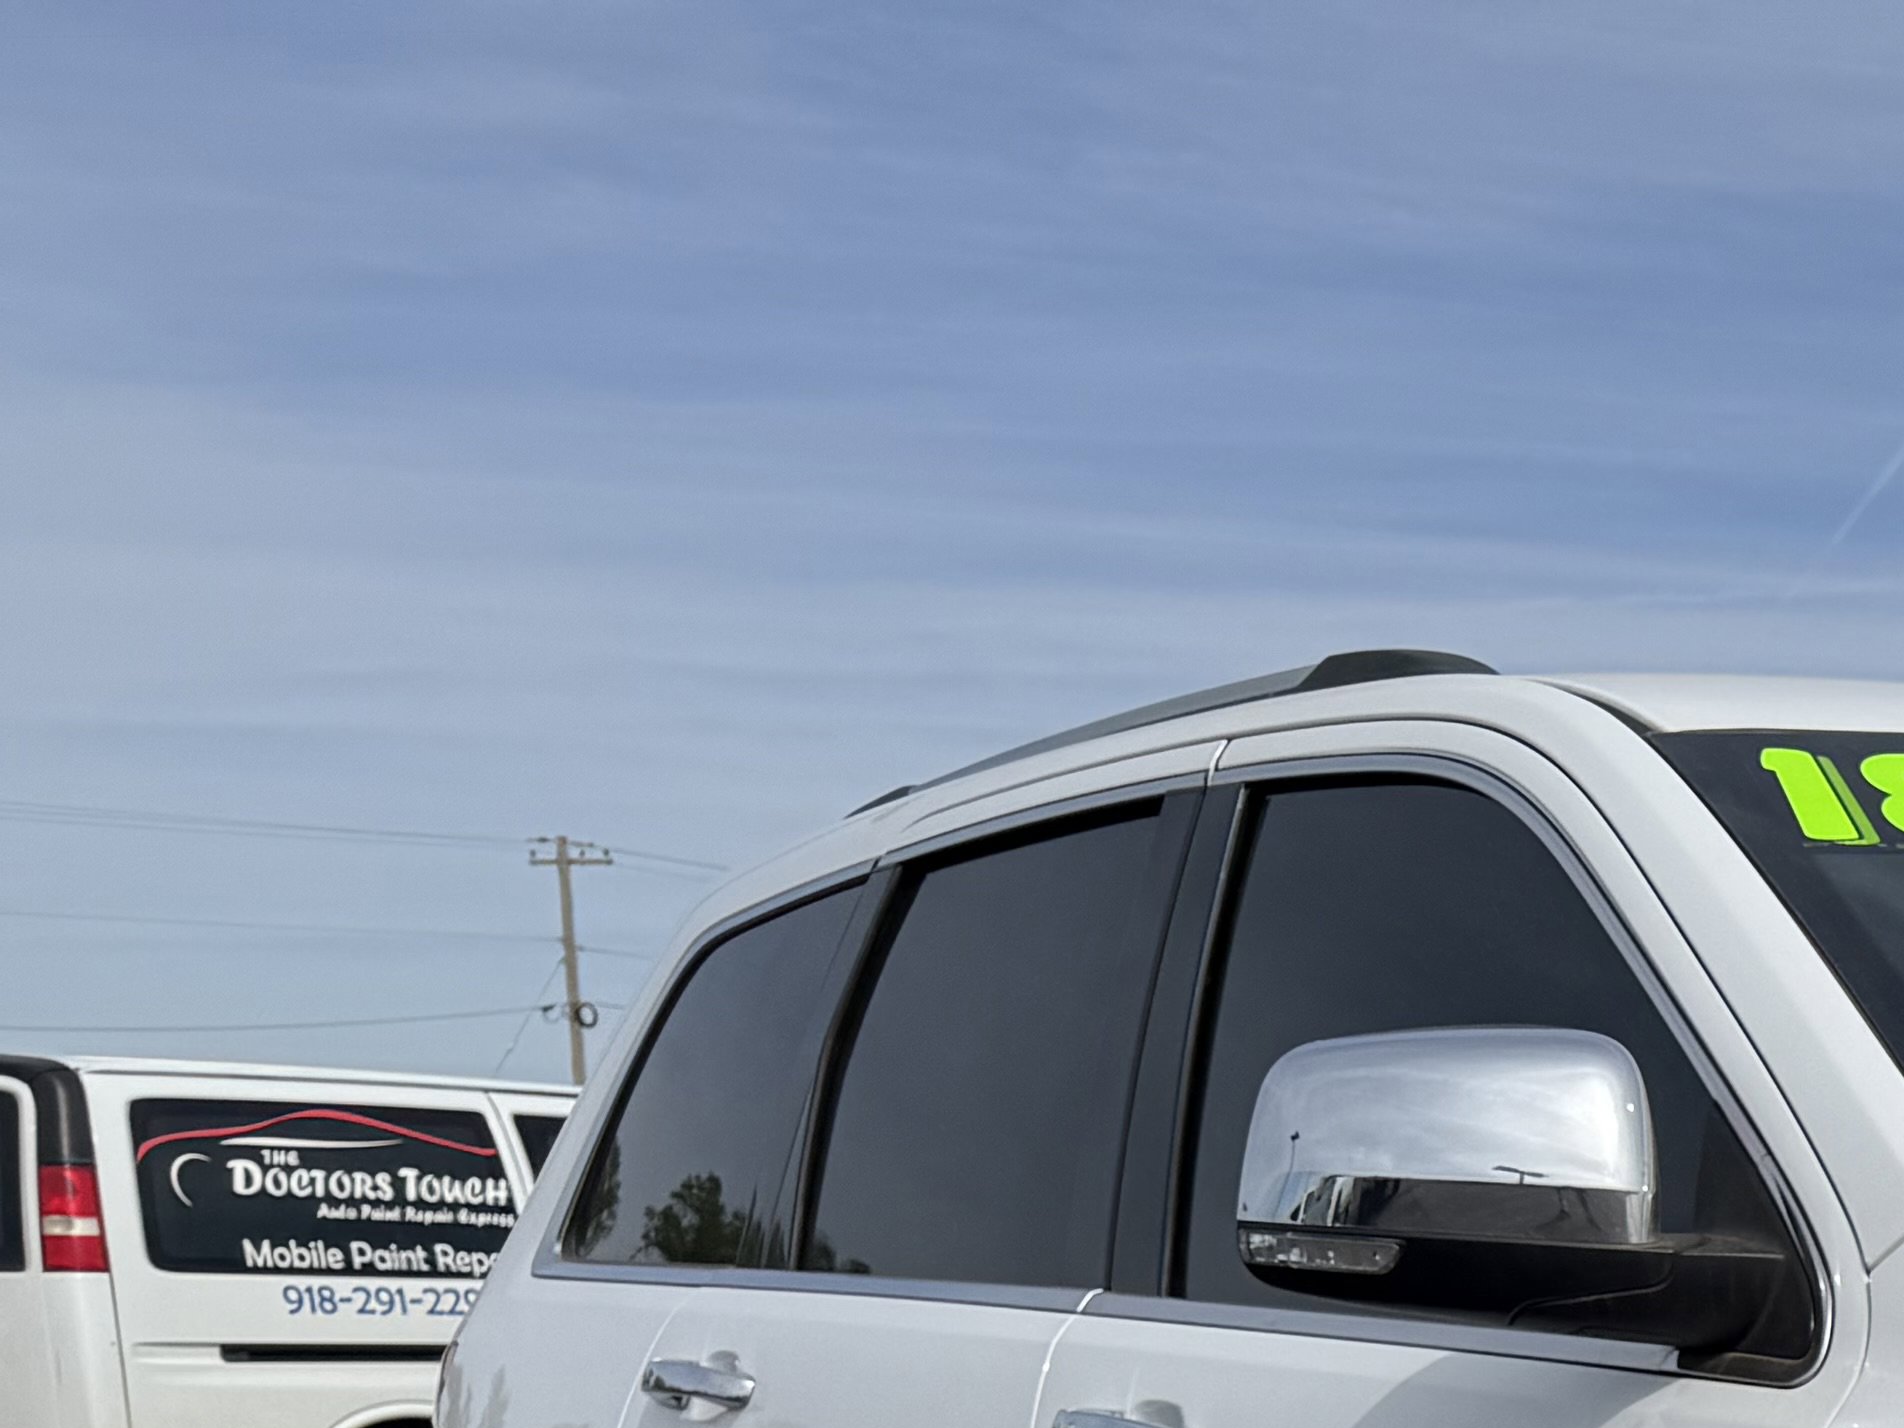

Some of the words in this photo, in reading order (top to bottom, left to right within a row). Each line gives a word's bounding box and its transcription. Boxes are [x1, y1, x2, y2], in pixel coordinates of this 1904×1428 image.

[260, 1149, 300, 1166] THE
[242, 1238, 346, 1270] Mobile
[349, 1241, 430, 1272] Paint
